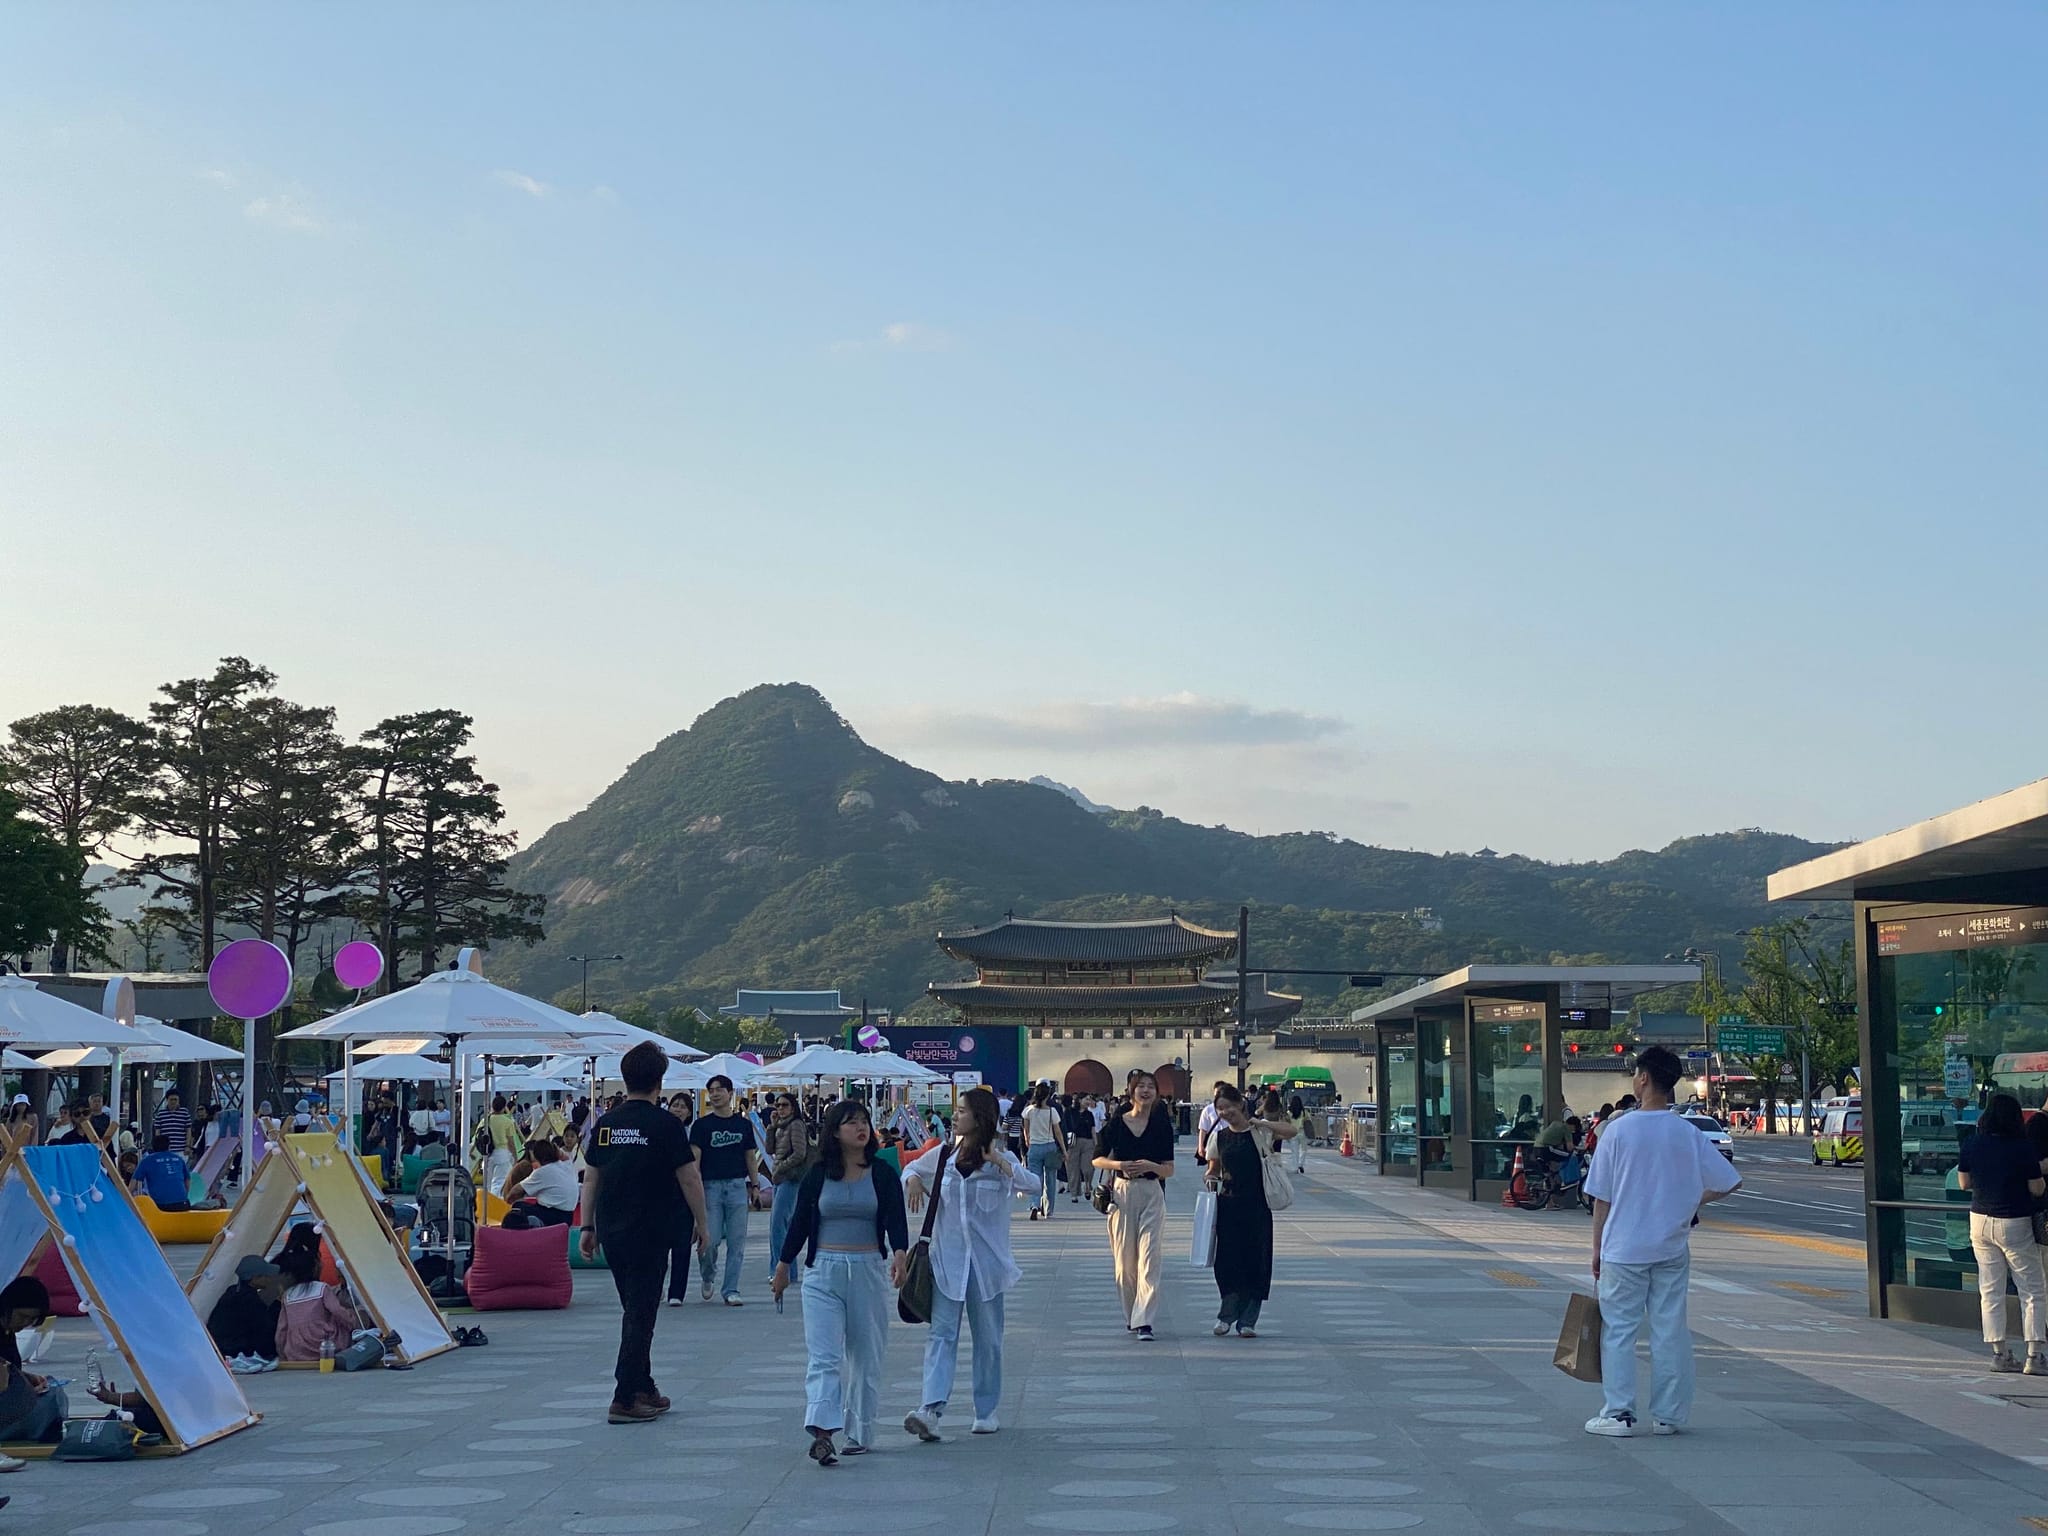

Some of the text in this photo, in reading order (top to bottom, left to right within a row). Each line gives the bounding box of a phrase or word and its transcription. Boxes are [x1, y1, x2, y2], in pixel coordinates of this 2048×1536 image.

[1968, 916, 2011, 931] 세종문화회관
[905, 1049, 958, 1061] 달빛낭만극장
[611, 1128, 640, 1137] NATIONAL
[610, 1136, 649, 1146] GEOGRAPHIC
